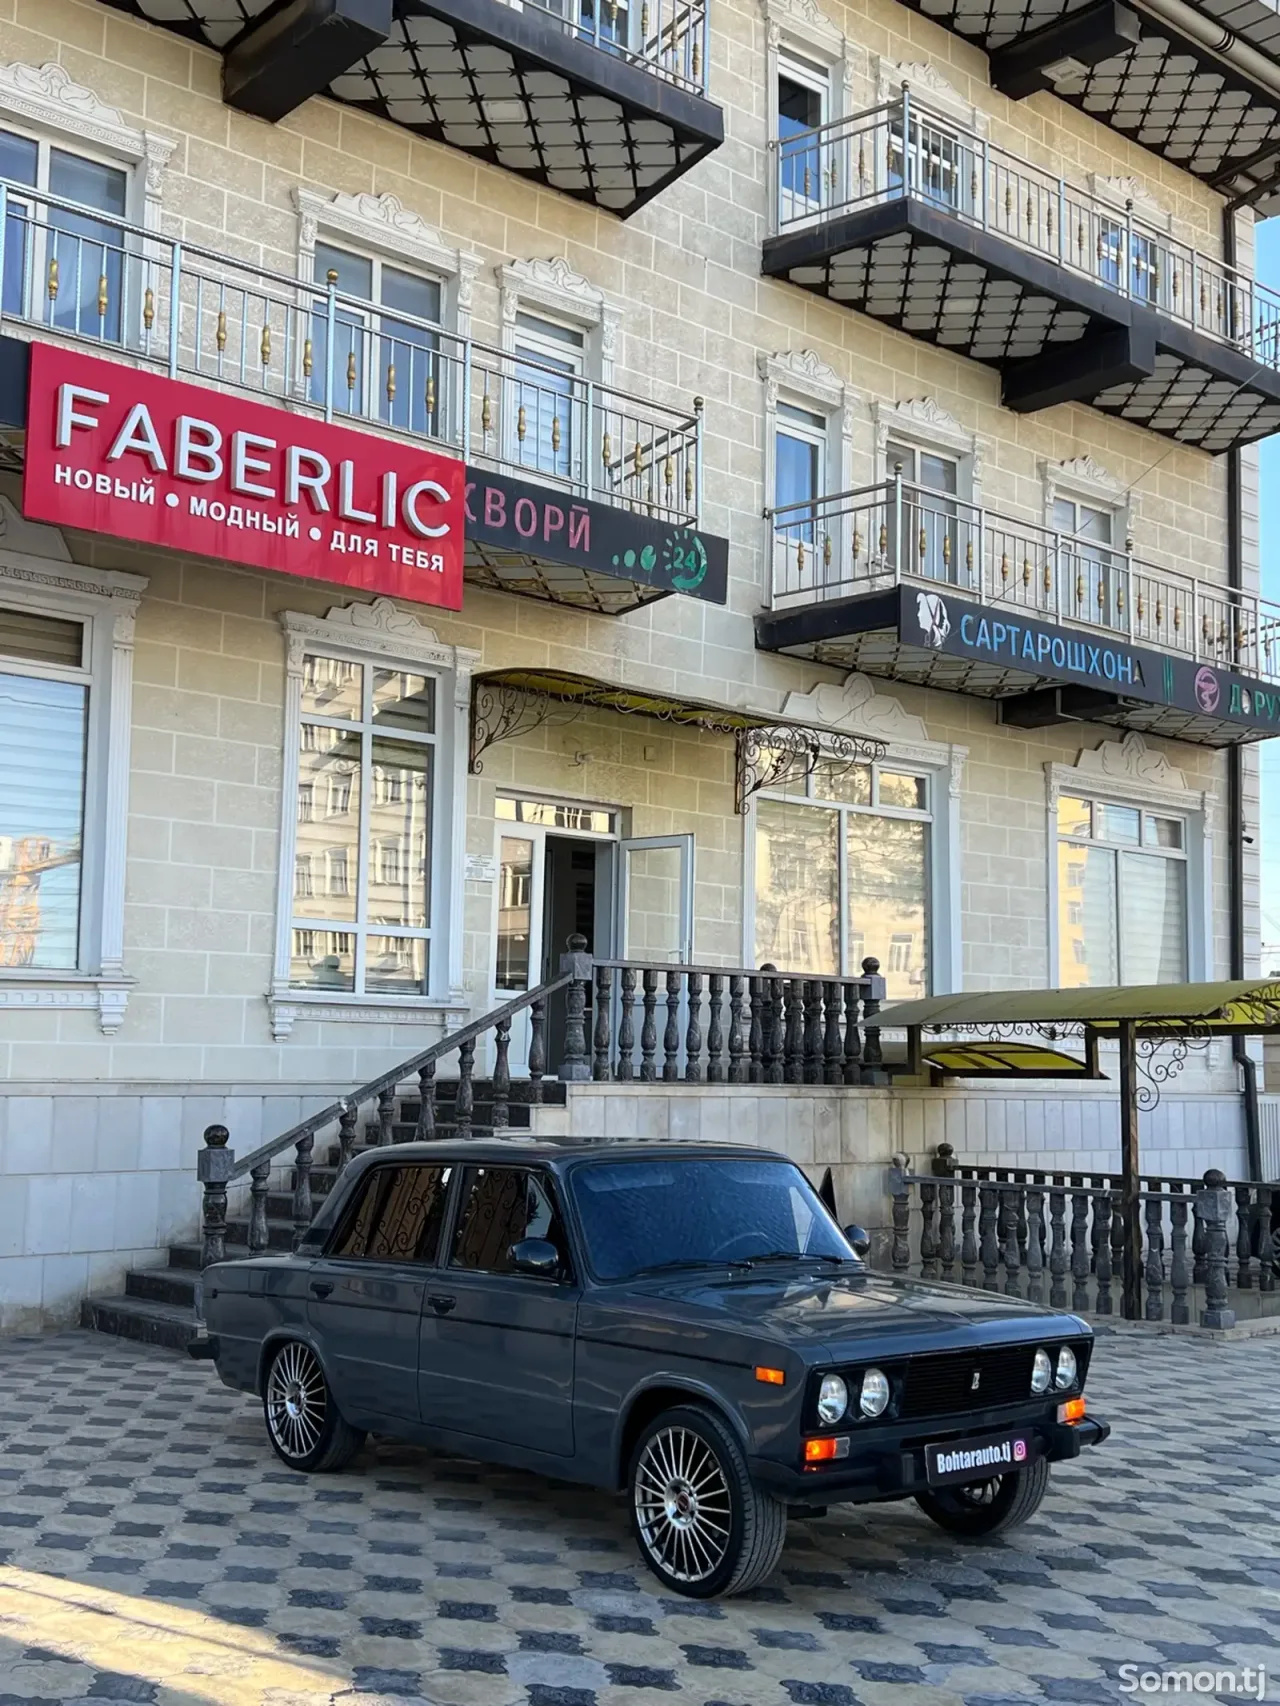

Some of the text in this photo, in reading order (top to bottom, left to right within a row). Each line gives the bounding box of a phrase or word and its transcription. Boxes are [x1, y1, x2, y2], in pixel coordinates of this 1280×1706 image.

[55, 382, 451, 539] FABERLIC
[54, 463, 445, 573] НОВЫЙ МОДНЫЙ ДЛЯ ТЕБЯ
[672, 546, 696, 571] 24
[960, 613, 1146, 688] САРТАРОШХОНА
[936, 1441, 1011, 1474] Bohtarauto.tj
